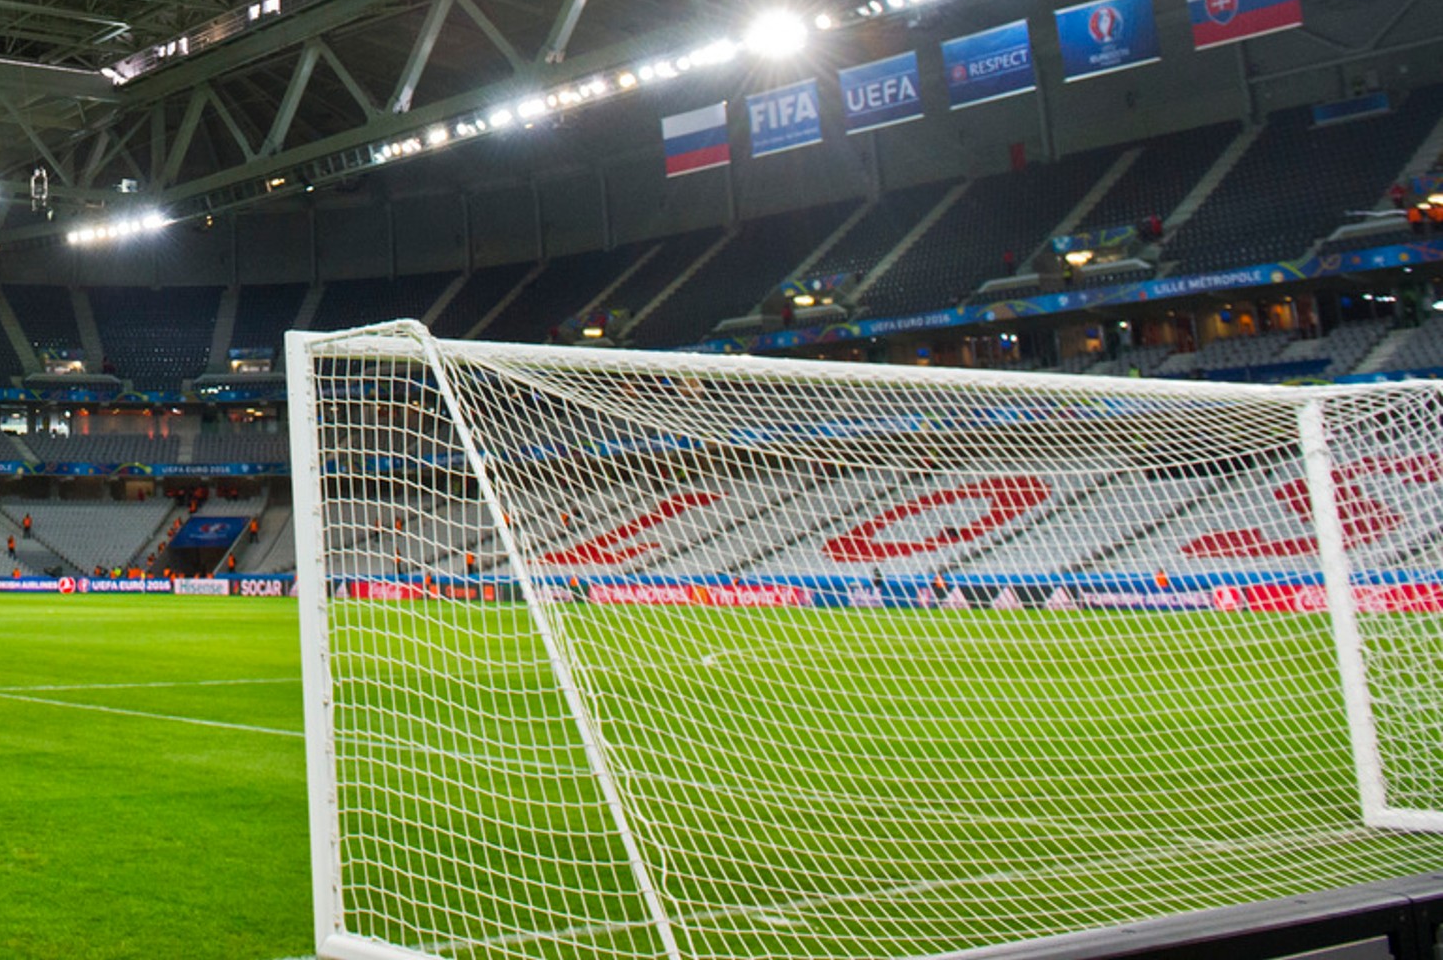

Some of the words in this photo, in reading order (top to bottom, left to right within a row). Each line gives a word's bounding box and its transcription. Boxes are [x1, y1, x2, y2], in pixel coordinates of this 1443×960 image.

[969, 49, 1029, 77] RESPECT
[846, 75, 917, 112] UEFA
[749, 90, 818, 134] FIFA
[1153, 281, 1186, 294] LILLE
[870, 321, 896, 333] UEFA
[897, 317, 924, 329] EURO
[925, 313, 951, 326] 2016
[161, 465, 184, 473] UEFA
[185, 466, 209, 474] EURO
[91, 580, 118, 591] UEFA
[119, 580, 146, 591] EURO
[146, 580, 171, 591] 2016
[240, 579, 282, 596] SOCAR
